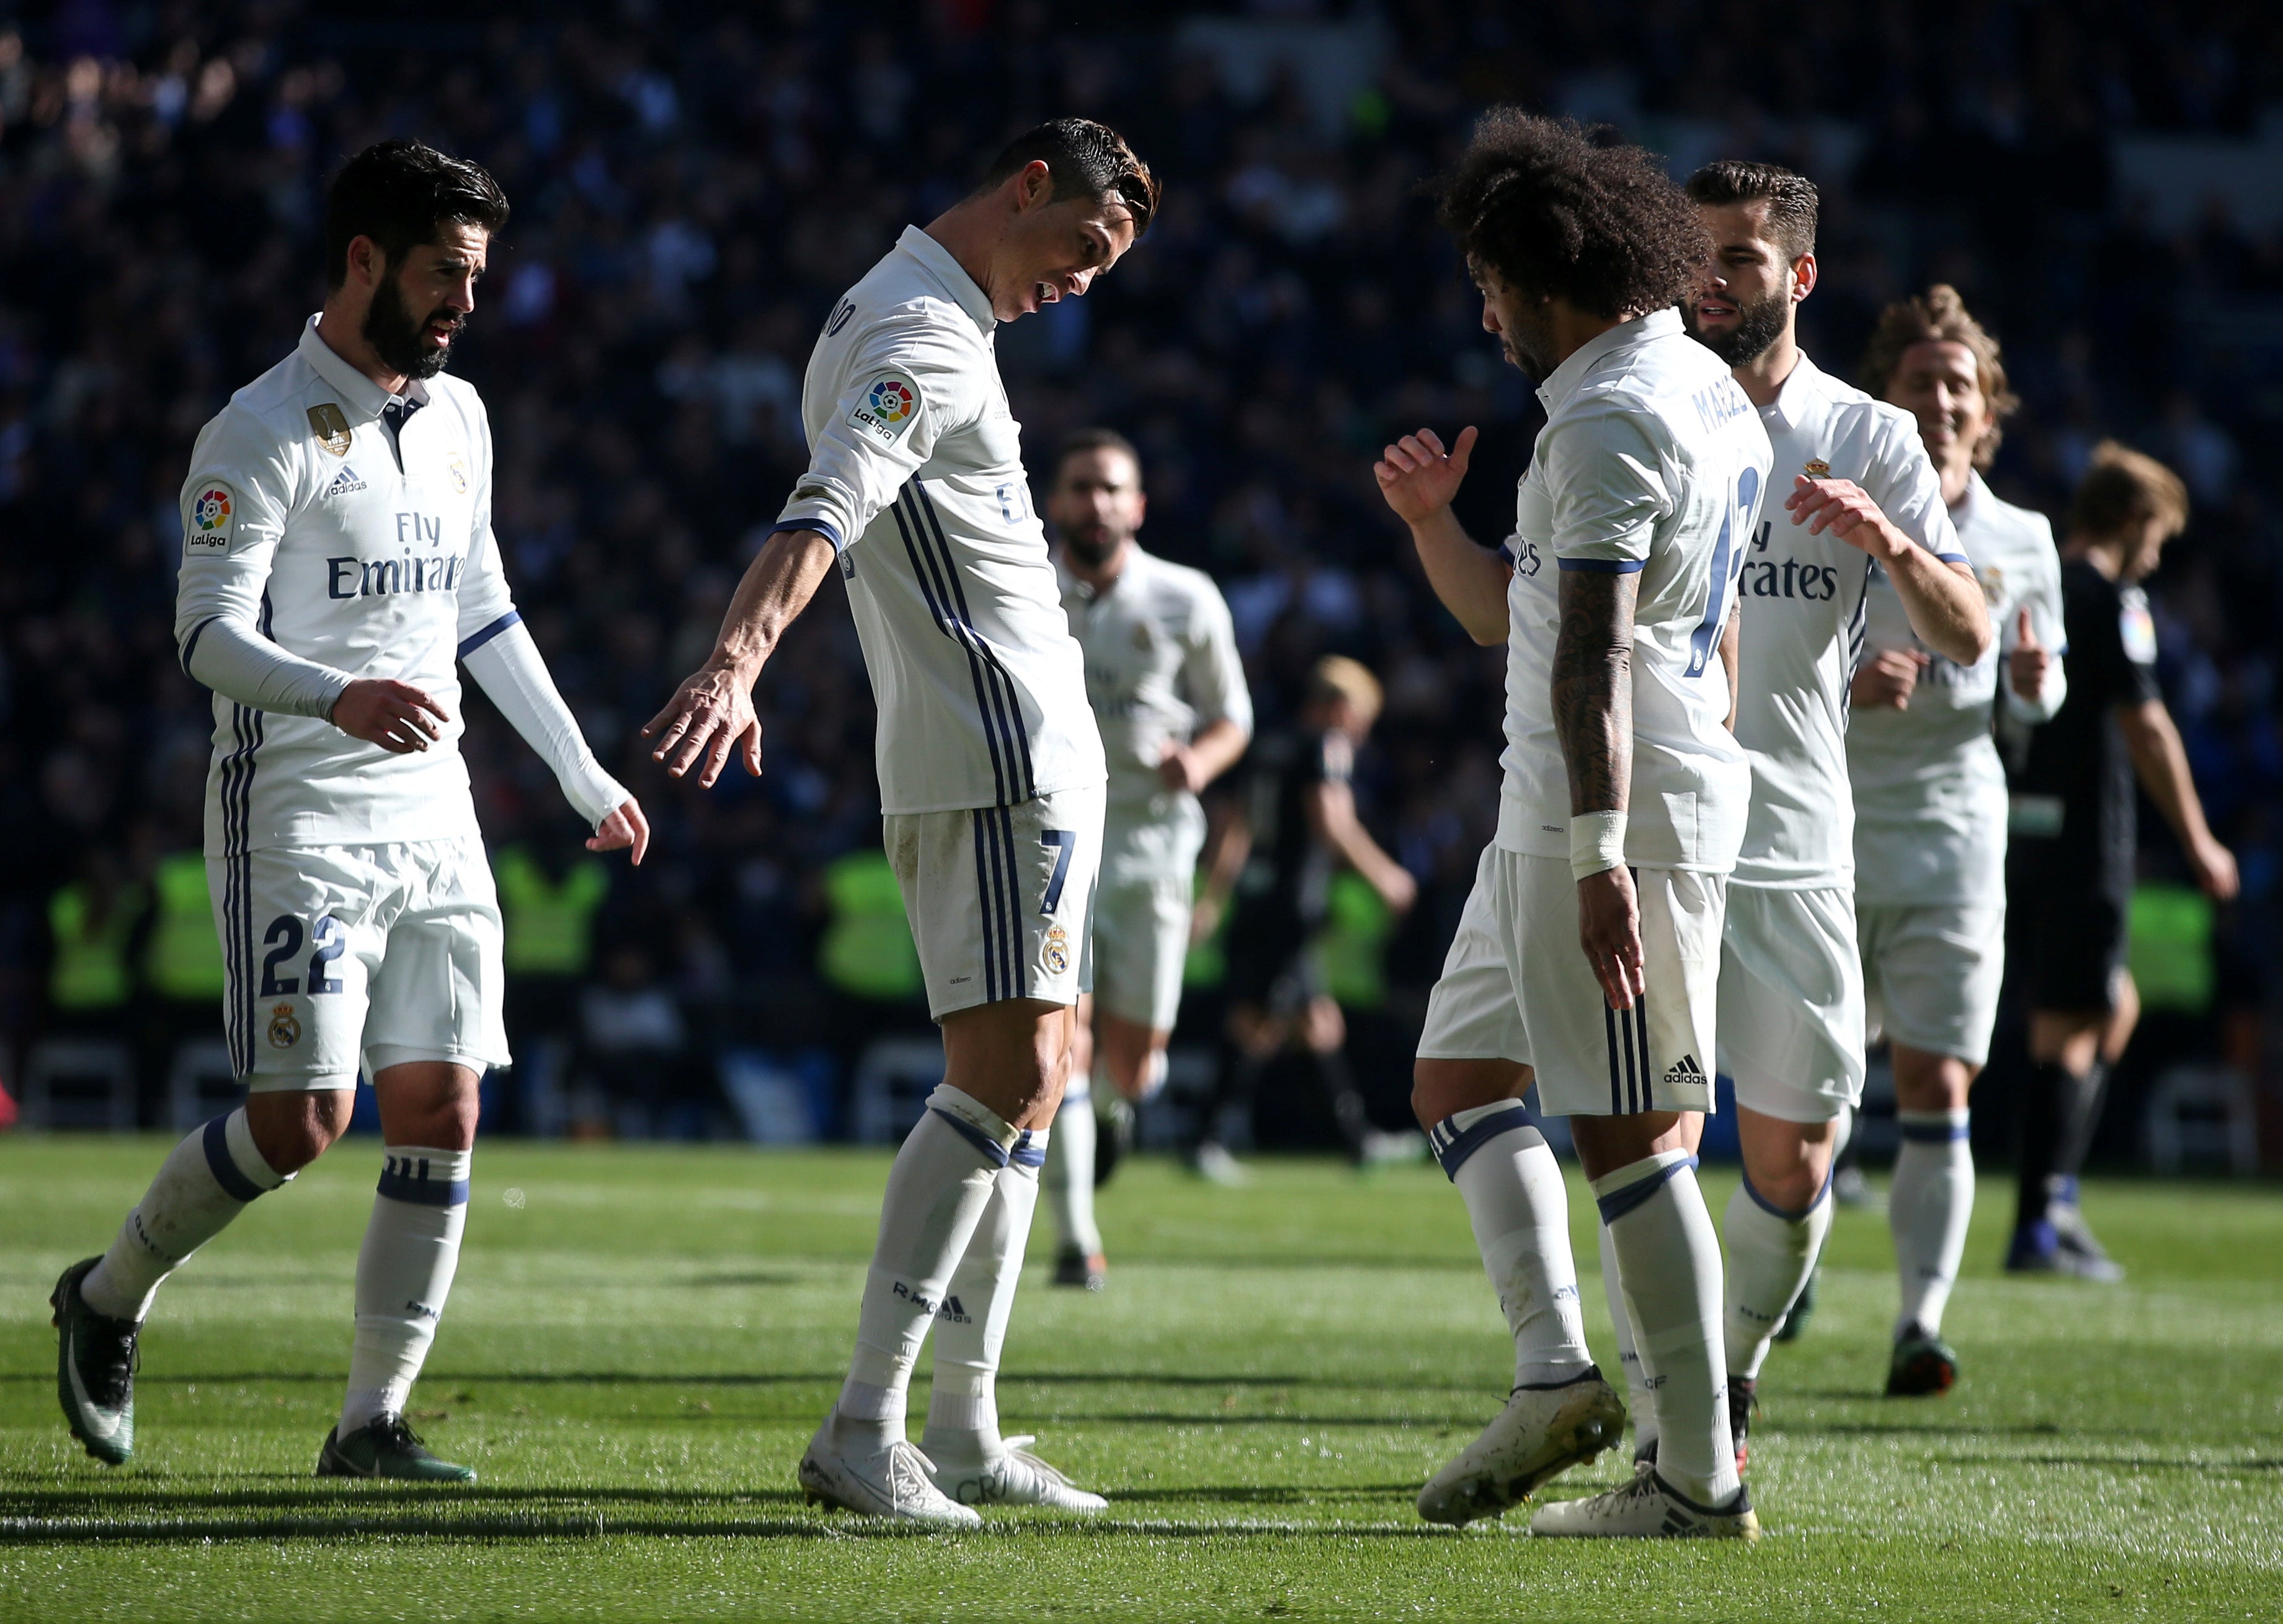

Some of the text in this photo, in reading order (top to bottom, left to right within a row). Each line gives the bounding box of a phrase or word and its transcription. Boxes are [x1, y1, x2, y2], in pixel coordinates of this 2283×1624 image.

[854, 408, 892, 440] LaLiga
[331, 481, 367, 495] adidas
[191, 533, 226, 548] LaLiga
[395, 512, 440, 548] Fly
[1039, 830, 1077, 915] 7
[260, 915, 345, 998] 22
[1663, 1072, 1707, 1085] adidas
